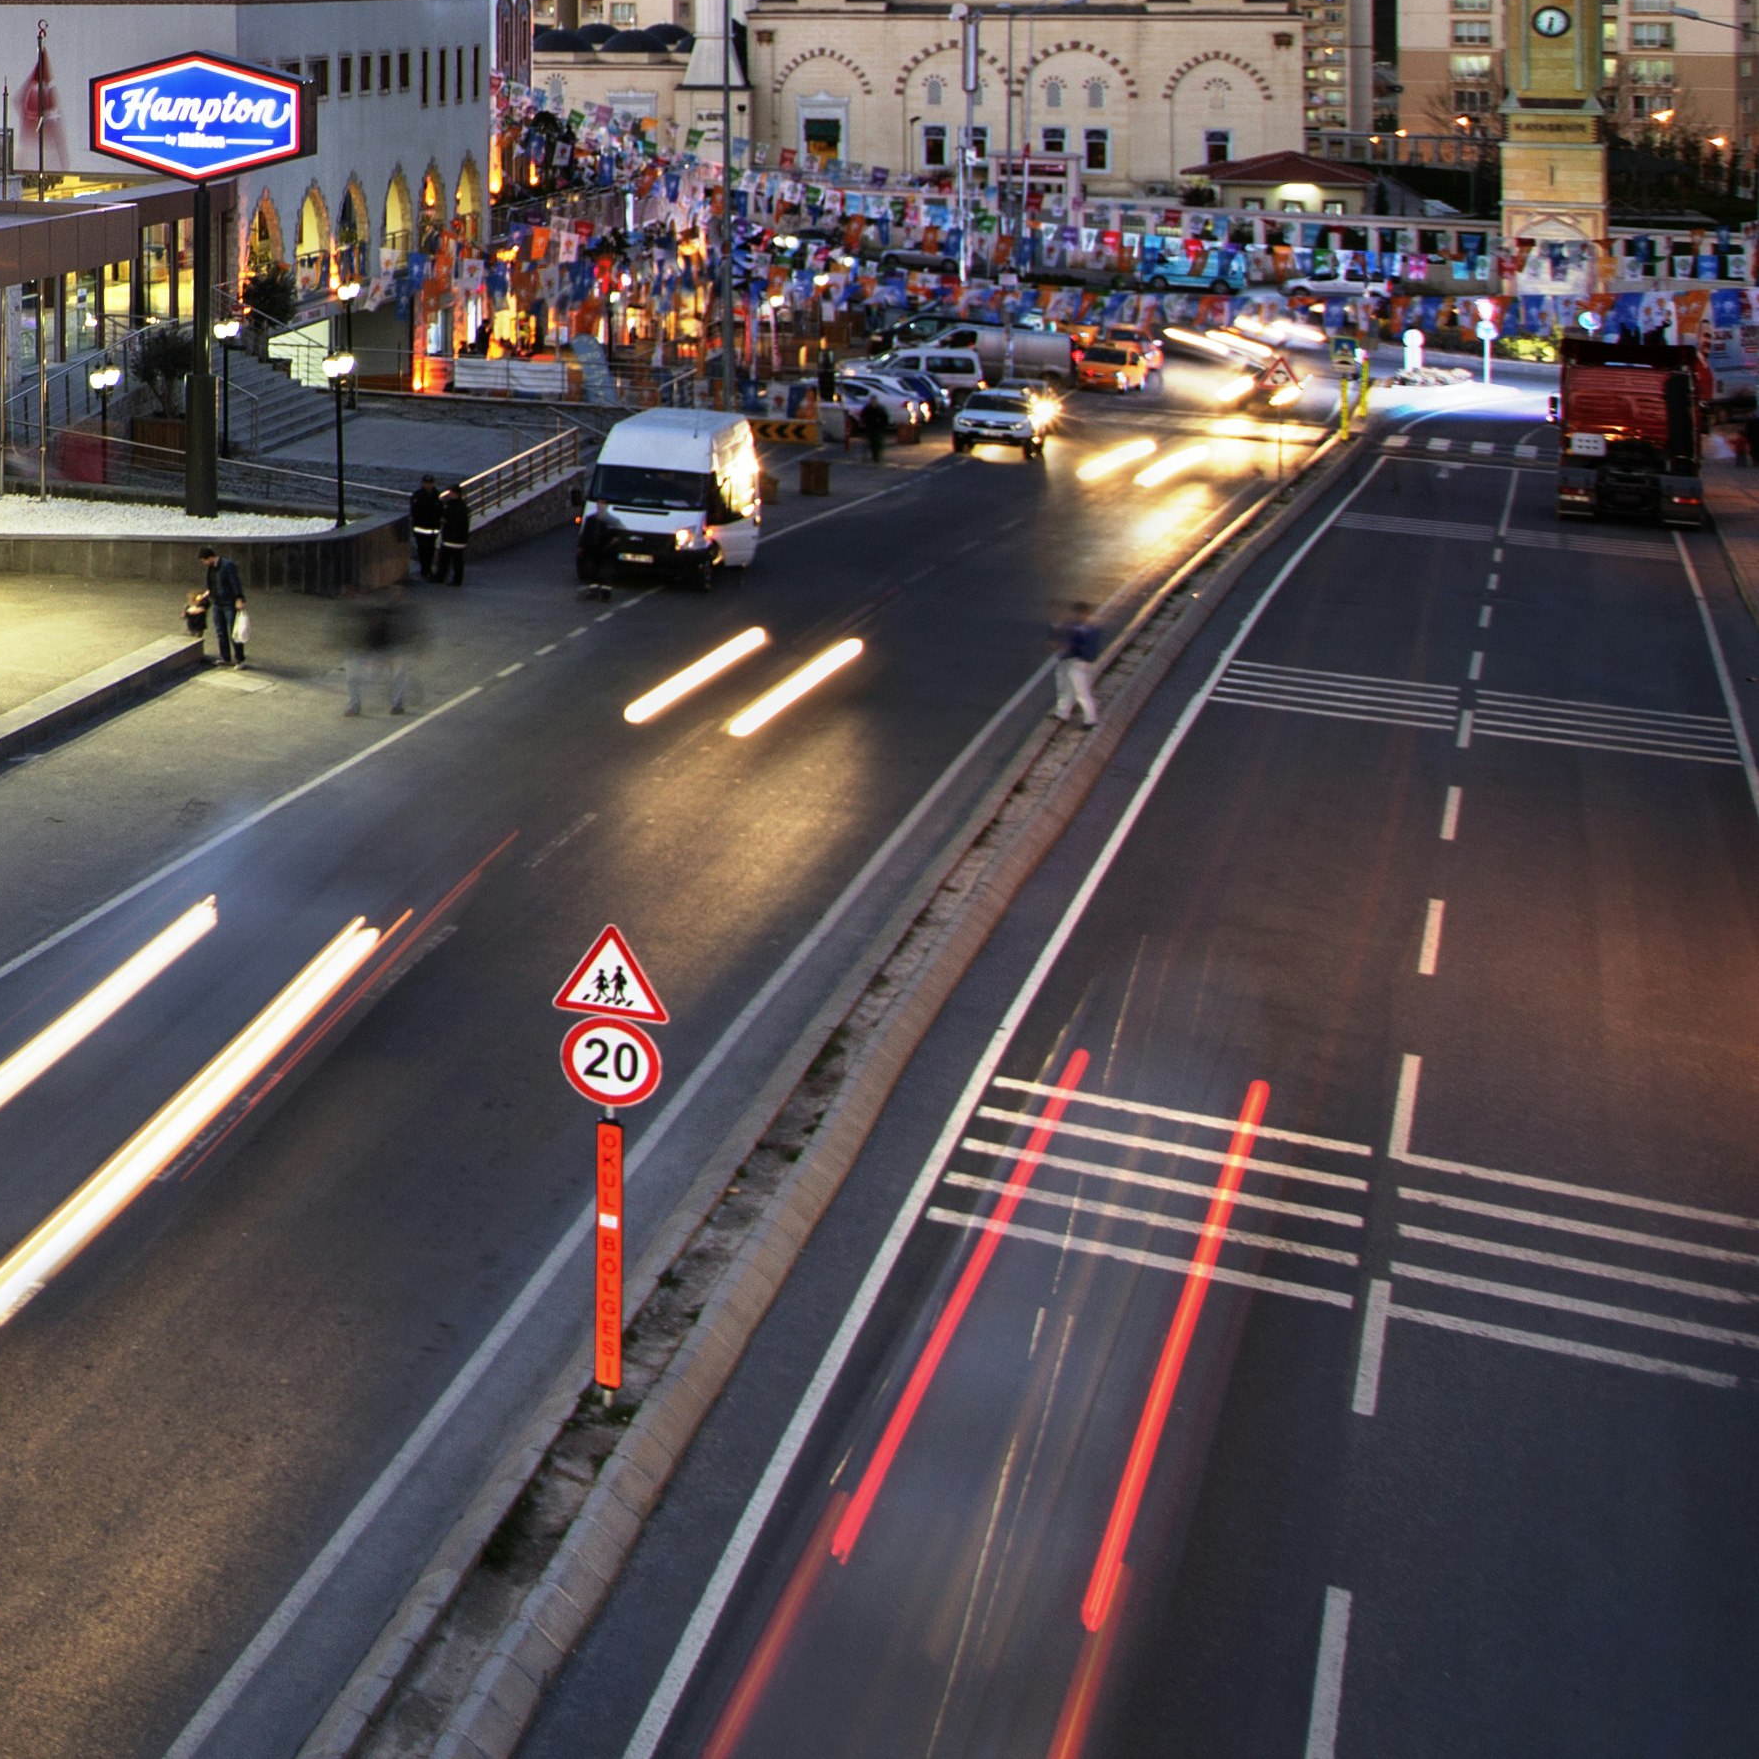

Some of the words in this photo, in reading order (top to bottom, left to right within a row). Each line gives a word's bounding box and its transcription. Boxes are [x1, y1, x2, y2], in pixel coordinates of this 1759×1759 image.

[104, 87, 292, 131] Hampton
[583, 1037, 639, 1083] 20
[601, 1133, 617, 1208] OKUL
